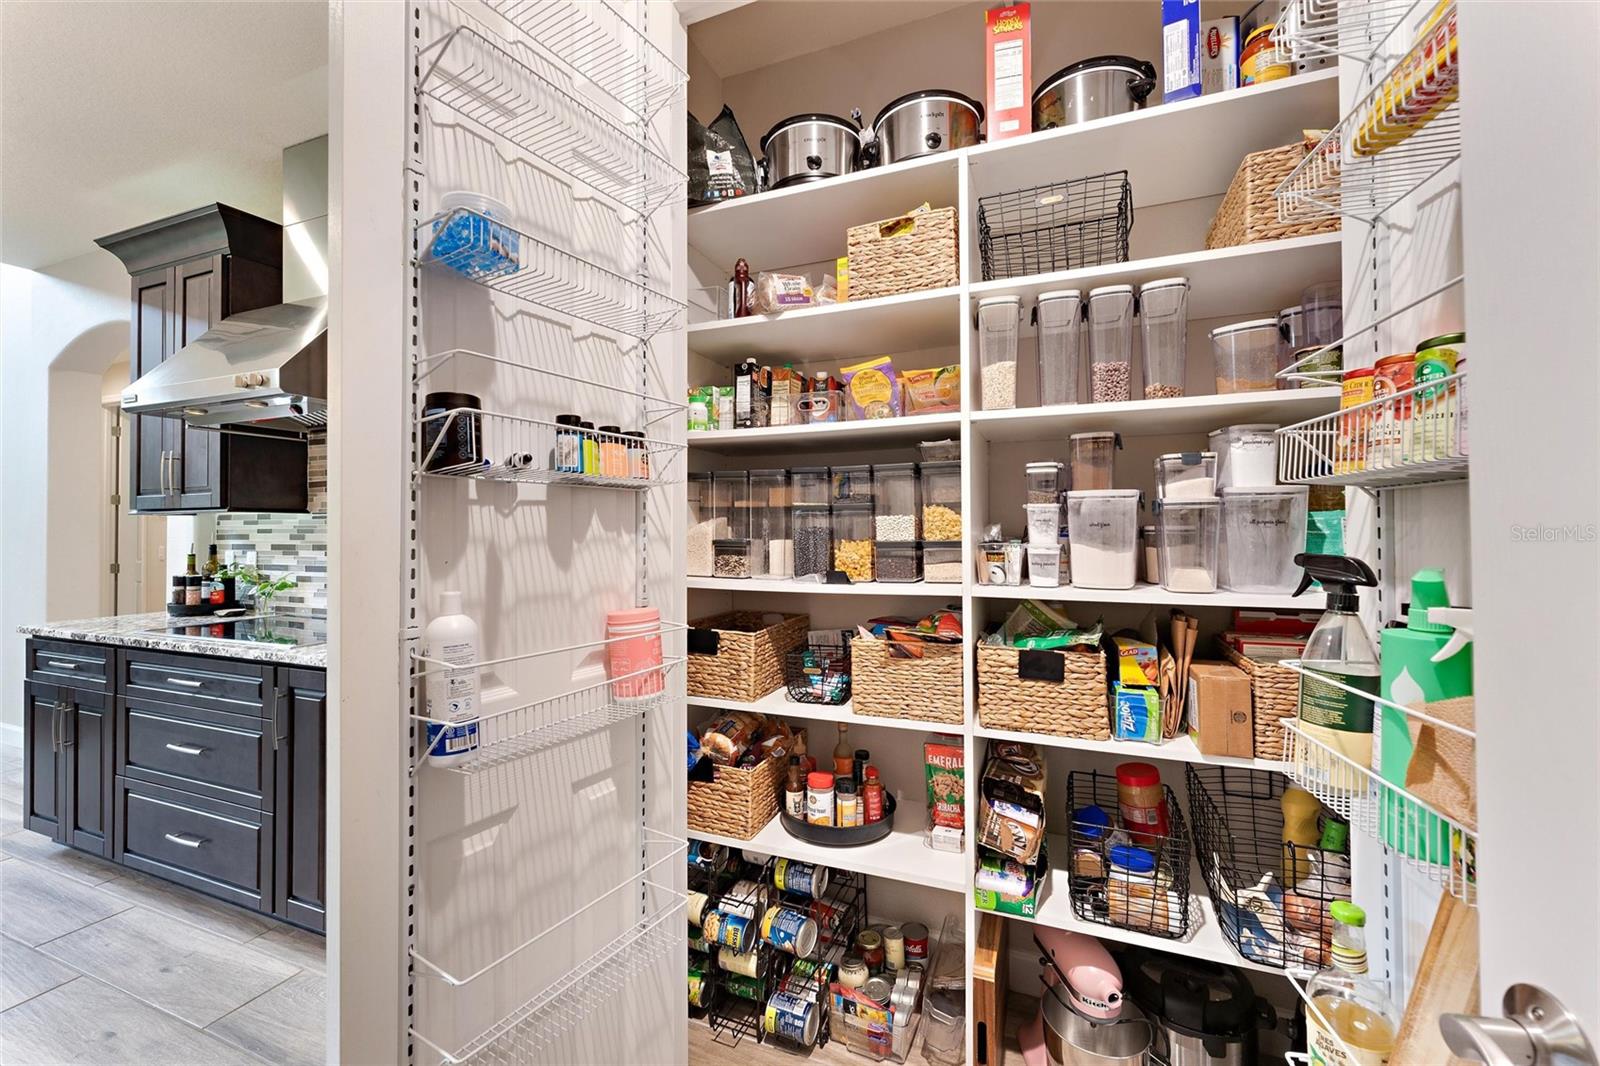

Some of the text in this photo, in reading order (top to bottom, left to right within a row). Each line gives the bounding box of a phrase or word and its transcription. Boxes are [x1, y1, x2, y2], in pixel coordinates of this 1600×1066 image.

[1119, 700, 1137, 733] Ziploc
[928, 754, 964, 769] EMERAL
[1082, 997, 1108, 1008] Kitch
